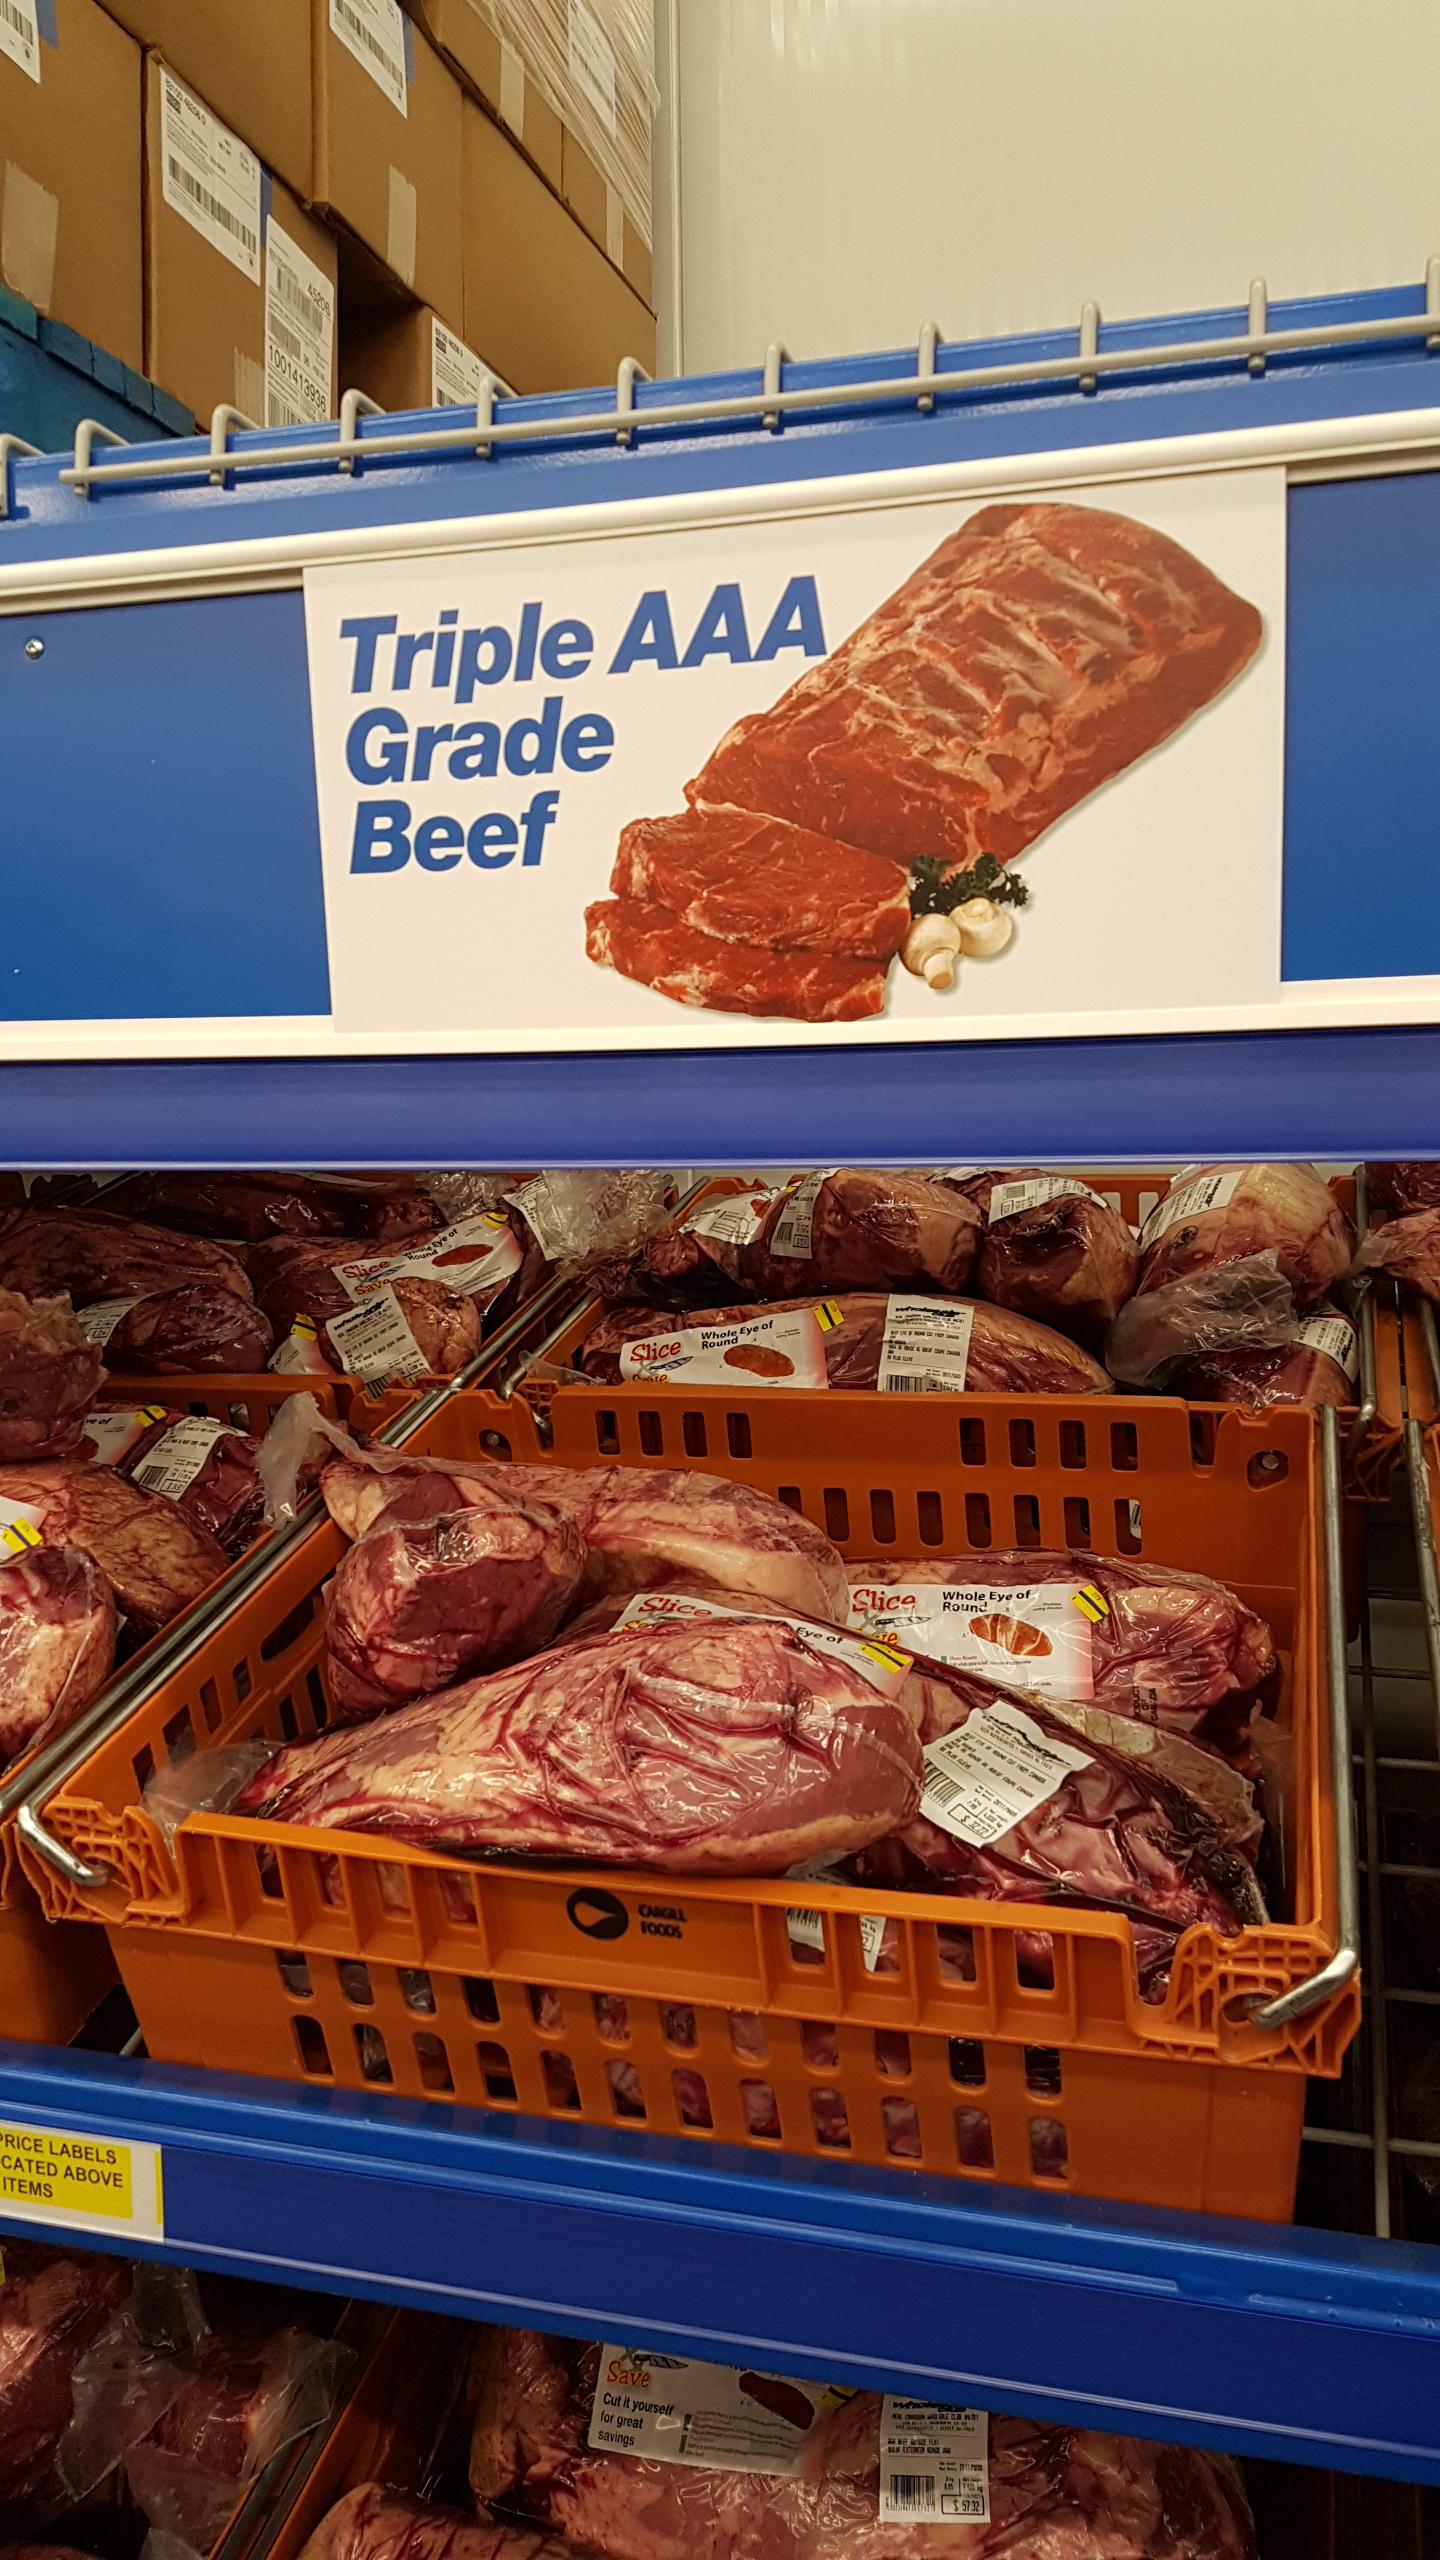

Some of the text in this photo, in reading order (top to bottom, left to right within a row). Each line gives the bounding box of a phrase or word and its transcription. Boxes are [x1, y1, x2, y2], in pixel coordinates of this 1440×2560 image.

[340, 575, 828, 704] Triple AAA
[346, 697, 614, 785] Grade
[350, 790, 560, 875] Beef
[342, 1260, 391, 1279] Slice
[701, 1319, 774, 1341] Whole Eye of
[630, 1341, 682, 1363] Slice
[701, 1336, 739, 1350] Round
[852, 1588, 917, 1613] Slice
[942, 1589, 1032, 1602] Whole Eye of
[638, 1596, 713, 1618] Slice
[942, 1601, 988, 1613] Round
[796, 1625, 844, 1646] Eye of
[638, 1903, 687, 1922] CARGILL
[640, 1920, 683, 1939] FOODS
[50, 2141, 117, 2165] LABELS
[3, 2176, 54, 2198] ITEMS
[63, 2165, 124, 2188] ABOVE
[607, 2360, 650, 2388] Save
[603, 2392, 675, 2416] Cut it yourself
[600, 2410, 644, 2429] for great
[597, 2430, 635, 2448] savings
